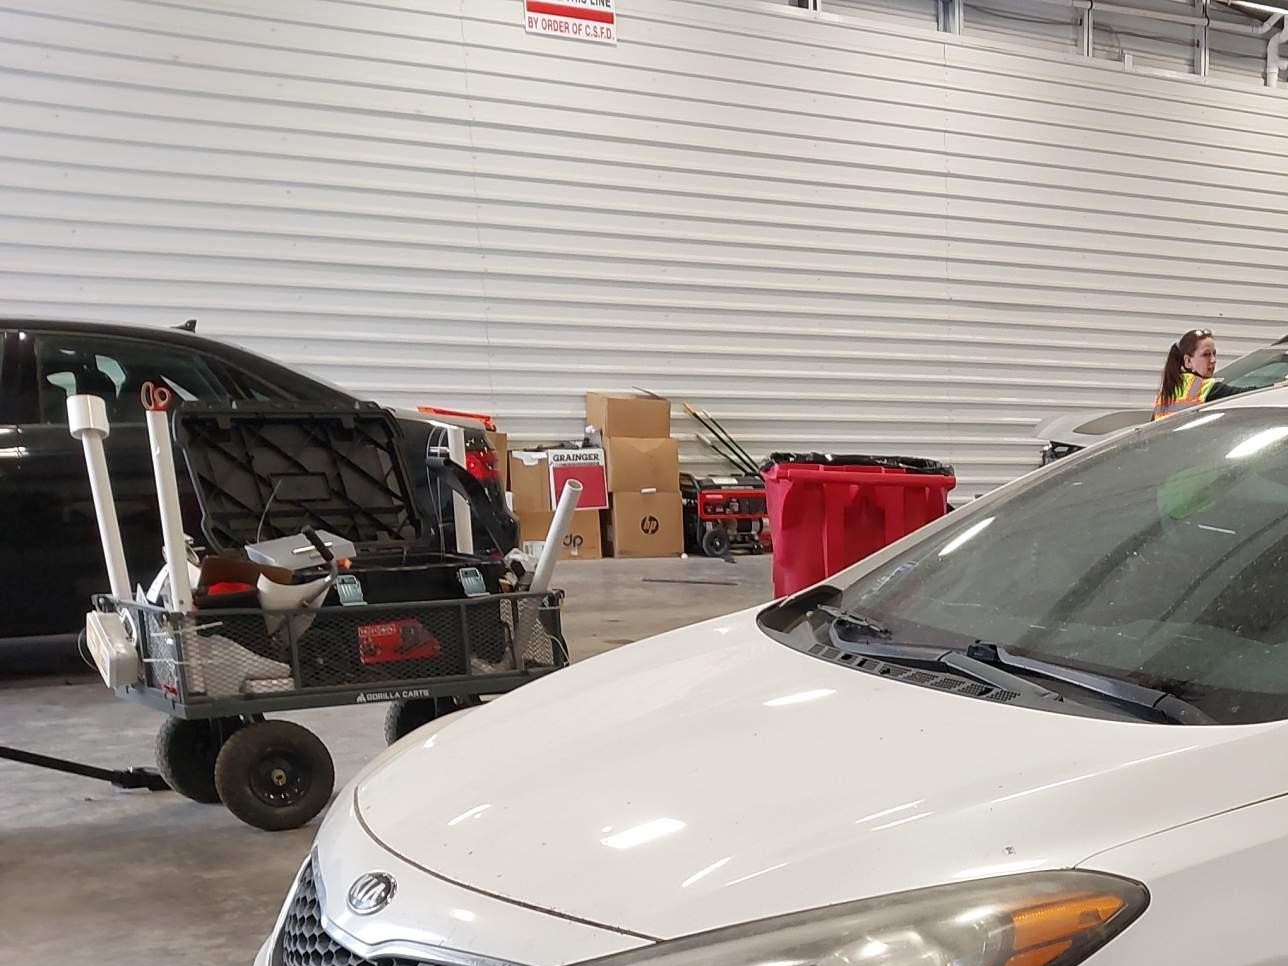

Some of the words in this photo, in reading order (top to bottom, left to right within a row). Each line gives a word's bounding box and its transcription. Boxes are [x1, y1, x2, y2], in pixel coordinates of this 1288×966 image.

[527, 16, 539, 29] BY
[541, 18, 570, 34] ORDER
[572, 23, 582, 35] OF
[584, 24, 615, 40] C.S.F.D.
[553, 453, 600, 462] GRAINGER
[641, 515, 659, 535] hp
